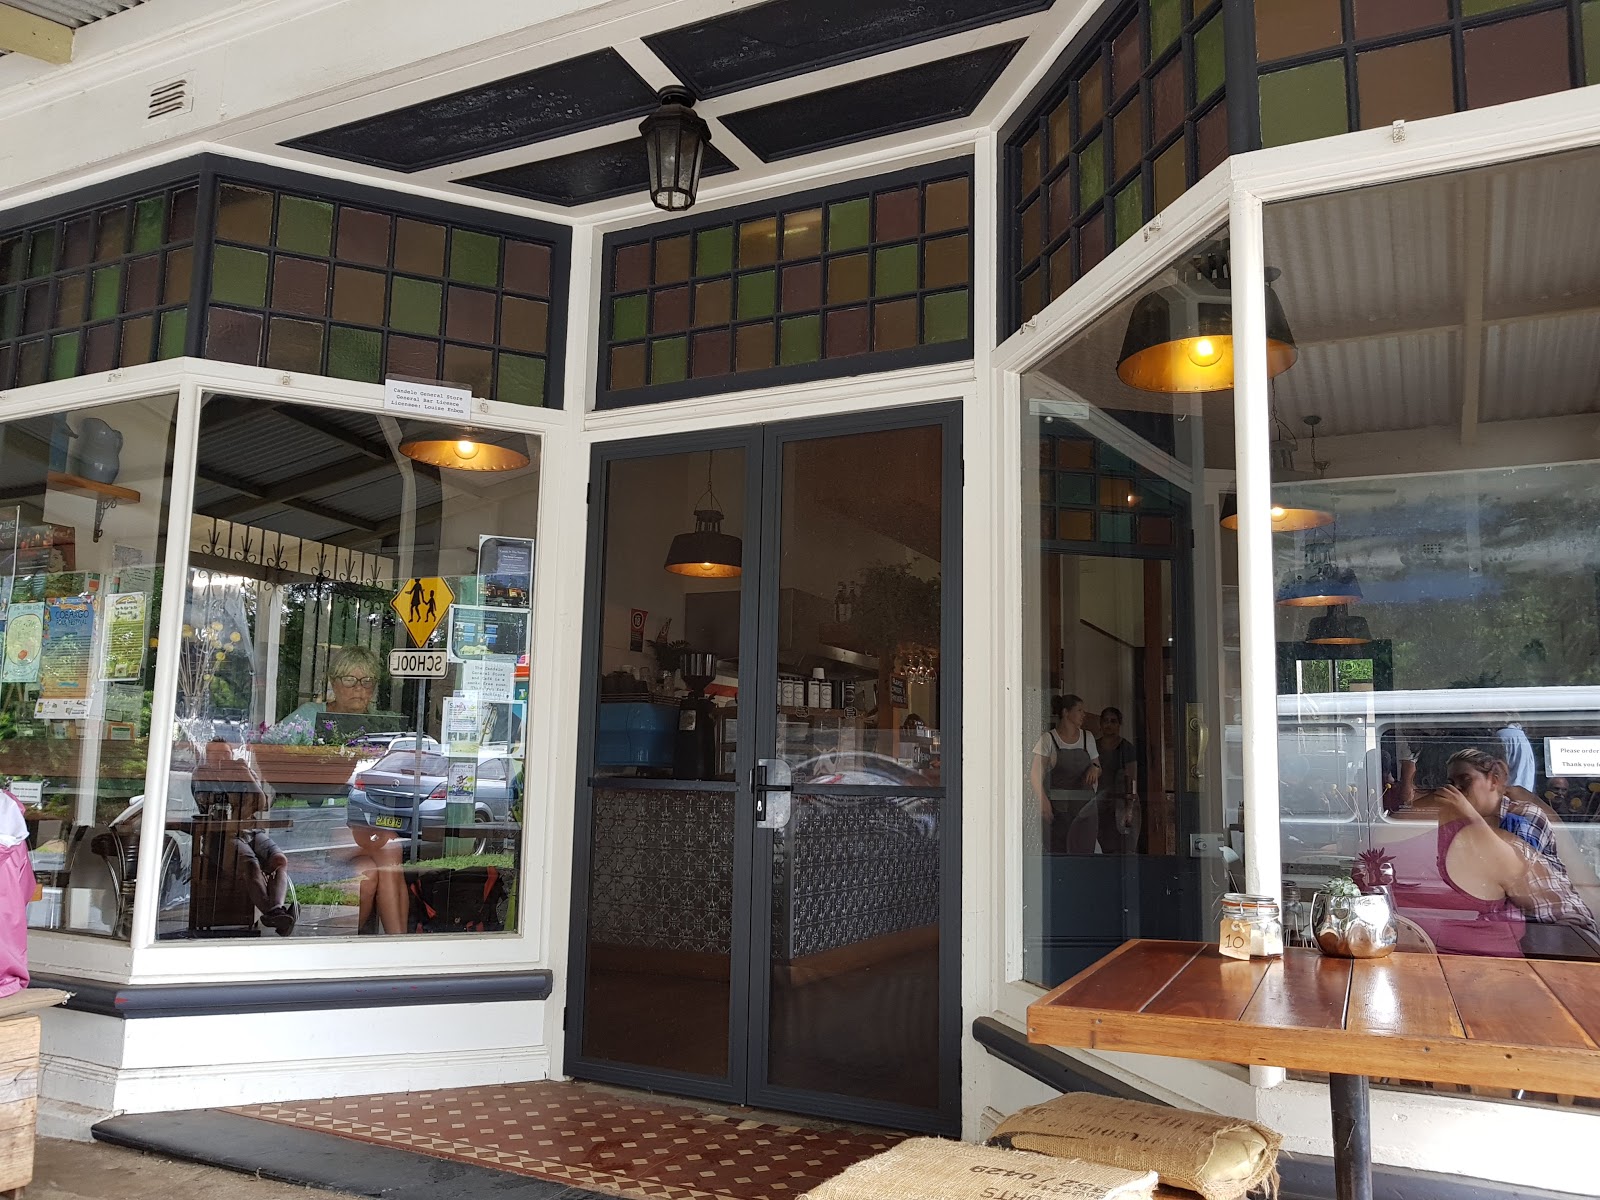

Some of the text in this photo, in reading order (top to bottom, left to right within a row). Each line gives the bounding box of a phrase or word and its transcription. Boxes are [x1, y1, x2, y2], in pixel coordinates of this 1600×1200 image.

[396, 394, 420, 402] General
[419, 391, 444, 399] General
[1225, 933, 1245, 949] 10
[969, 1165, 1037, 1180] 0429
